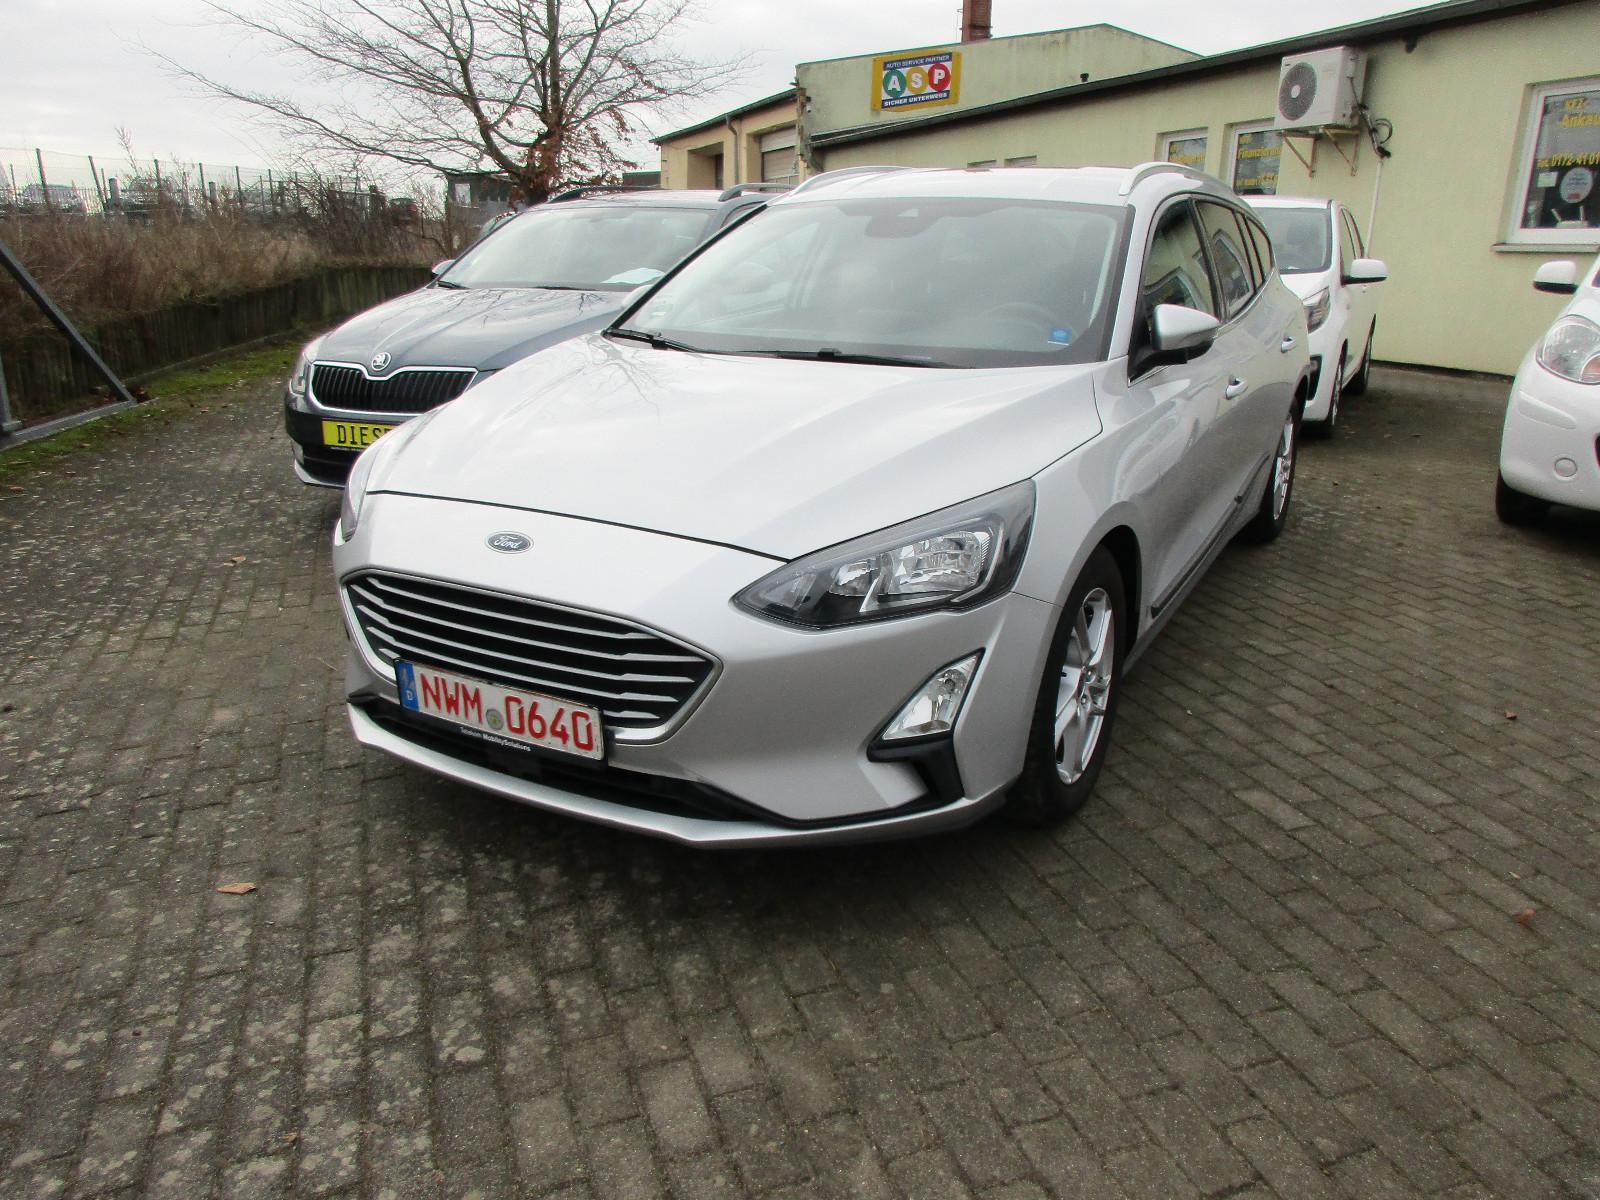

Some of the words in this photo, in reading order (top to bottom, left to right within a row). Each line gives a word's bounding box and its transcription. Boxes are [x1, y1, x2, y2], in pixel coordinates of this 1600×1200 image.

[902, 58, 924, 67] SERVICE
[925, 54, 950, 64] PARTNER
[884, 98, 908, 107] SICHER
[908, 92, 948, 103] UNTERWEGS
[494, 535, 523, 549] Ford
[419, 672, 483, 725] NWM
[504, 695, 594, 751] 0640
